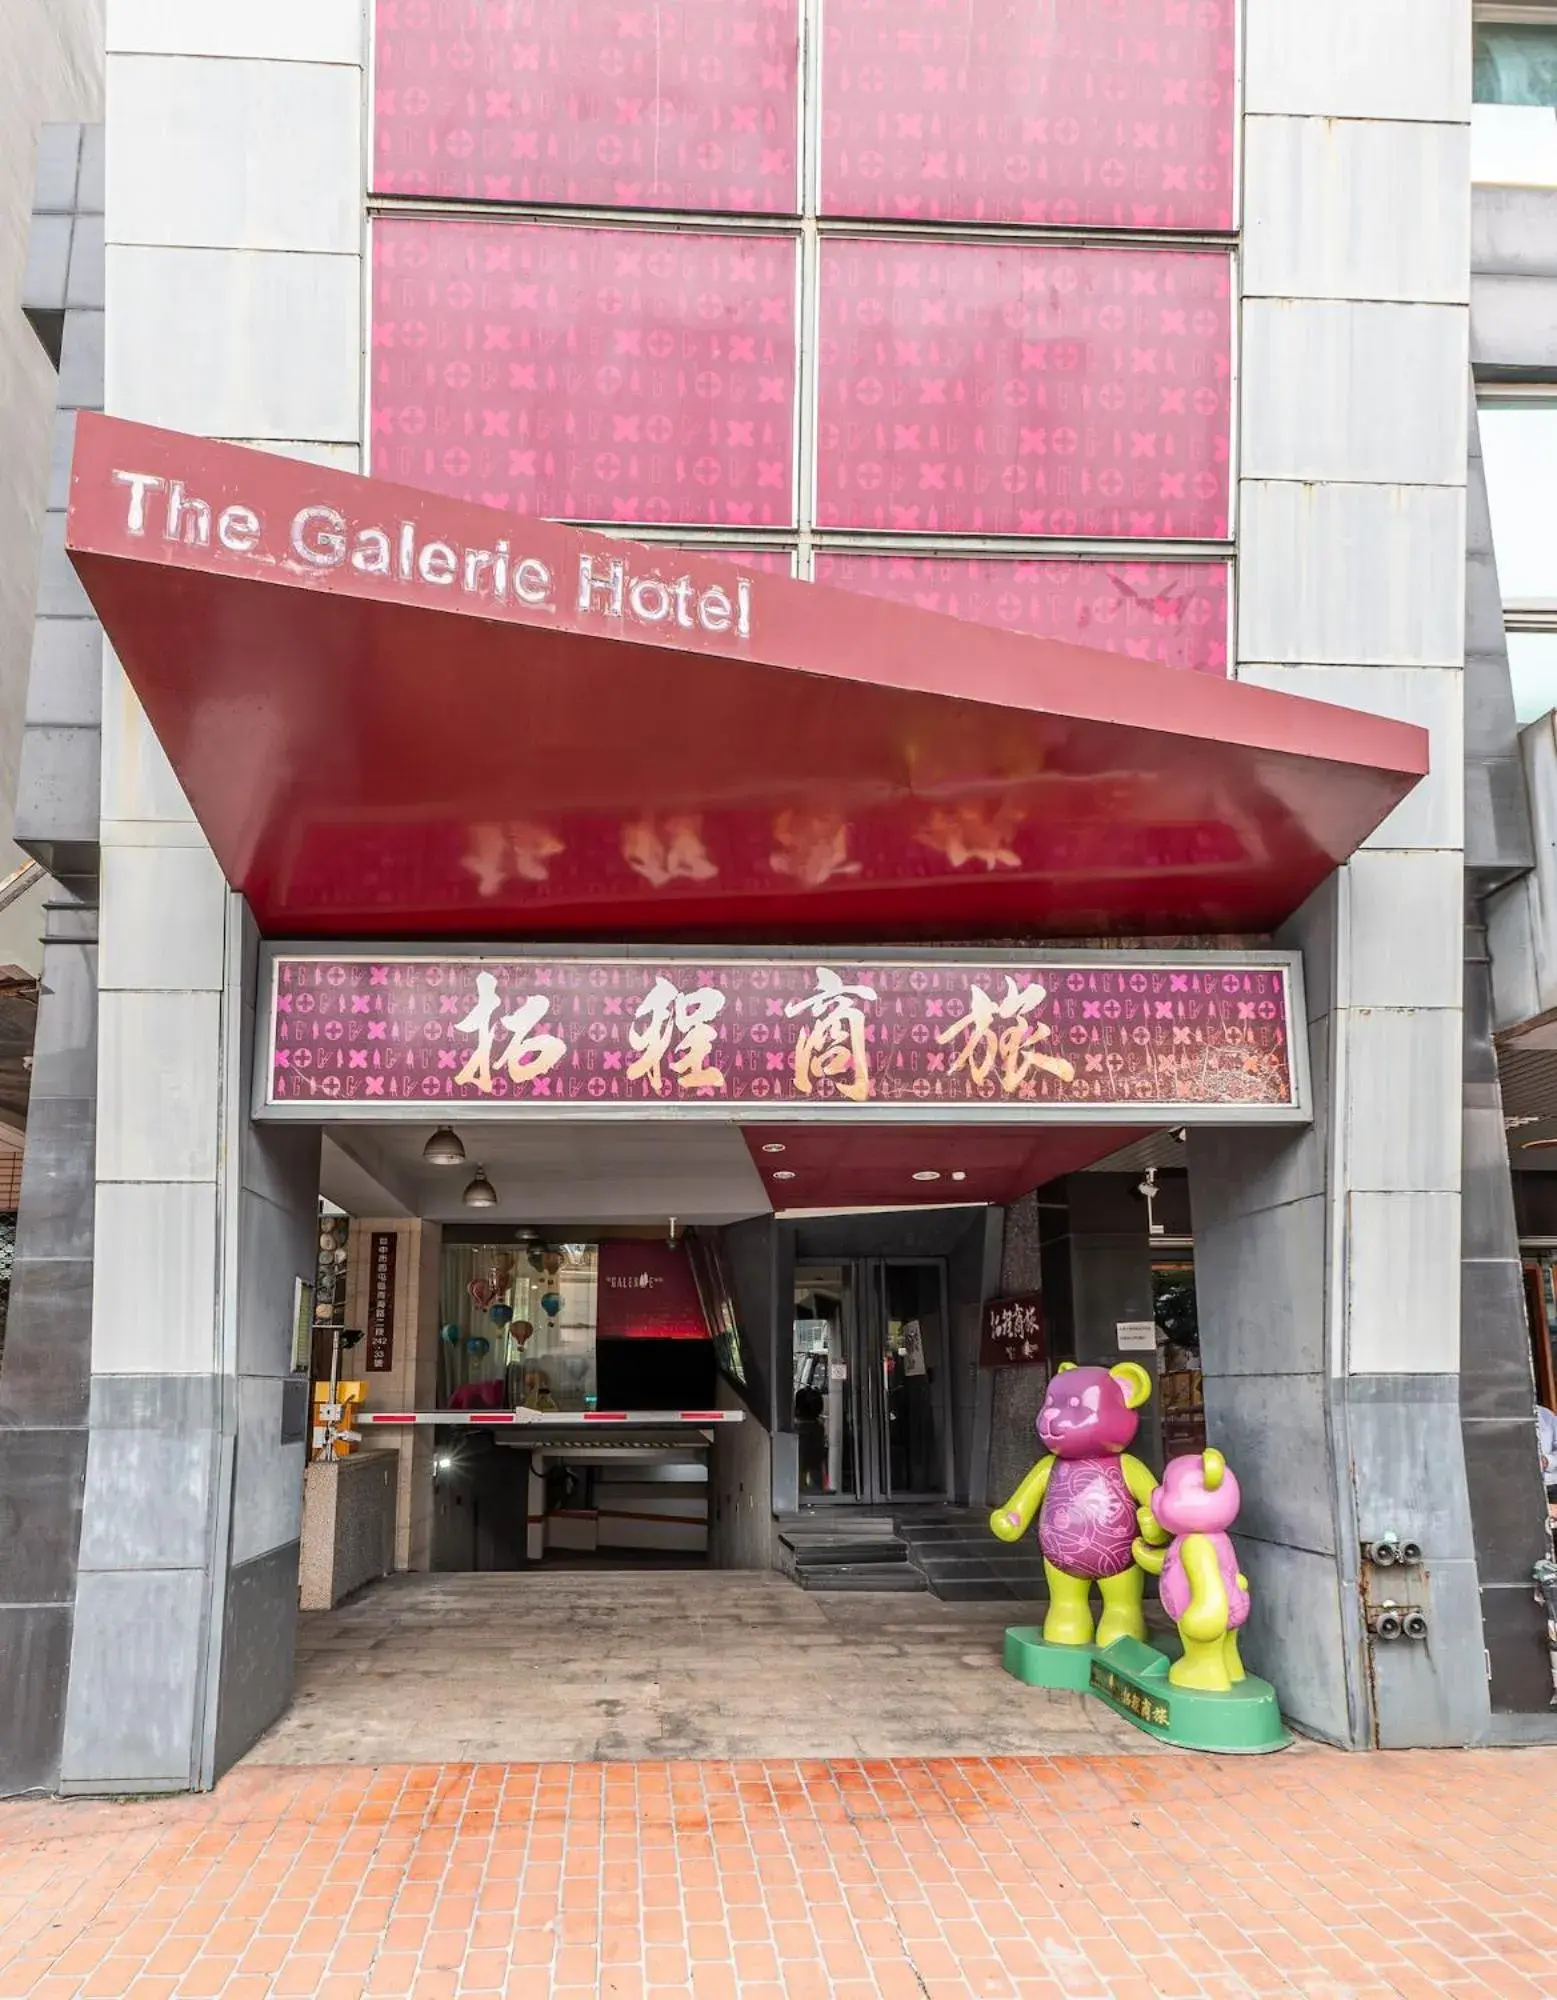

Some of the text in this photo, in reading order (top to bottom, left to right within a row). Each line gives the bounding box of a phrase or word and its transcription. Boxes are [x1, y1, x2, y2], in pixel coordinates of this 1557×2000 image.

[112, 469, 750, 639] The Galerie Hotel
[453, 966, 1075, 1102] 拓程商旅
